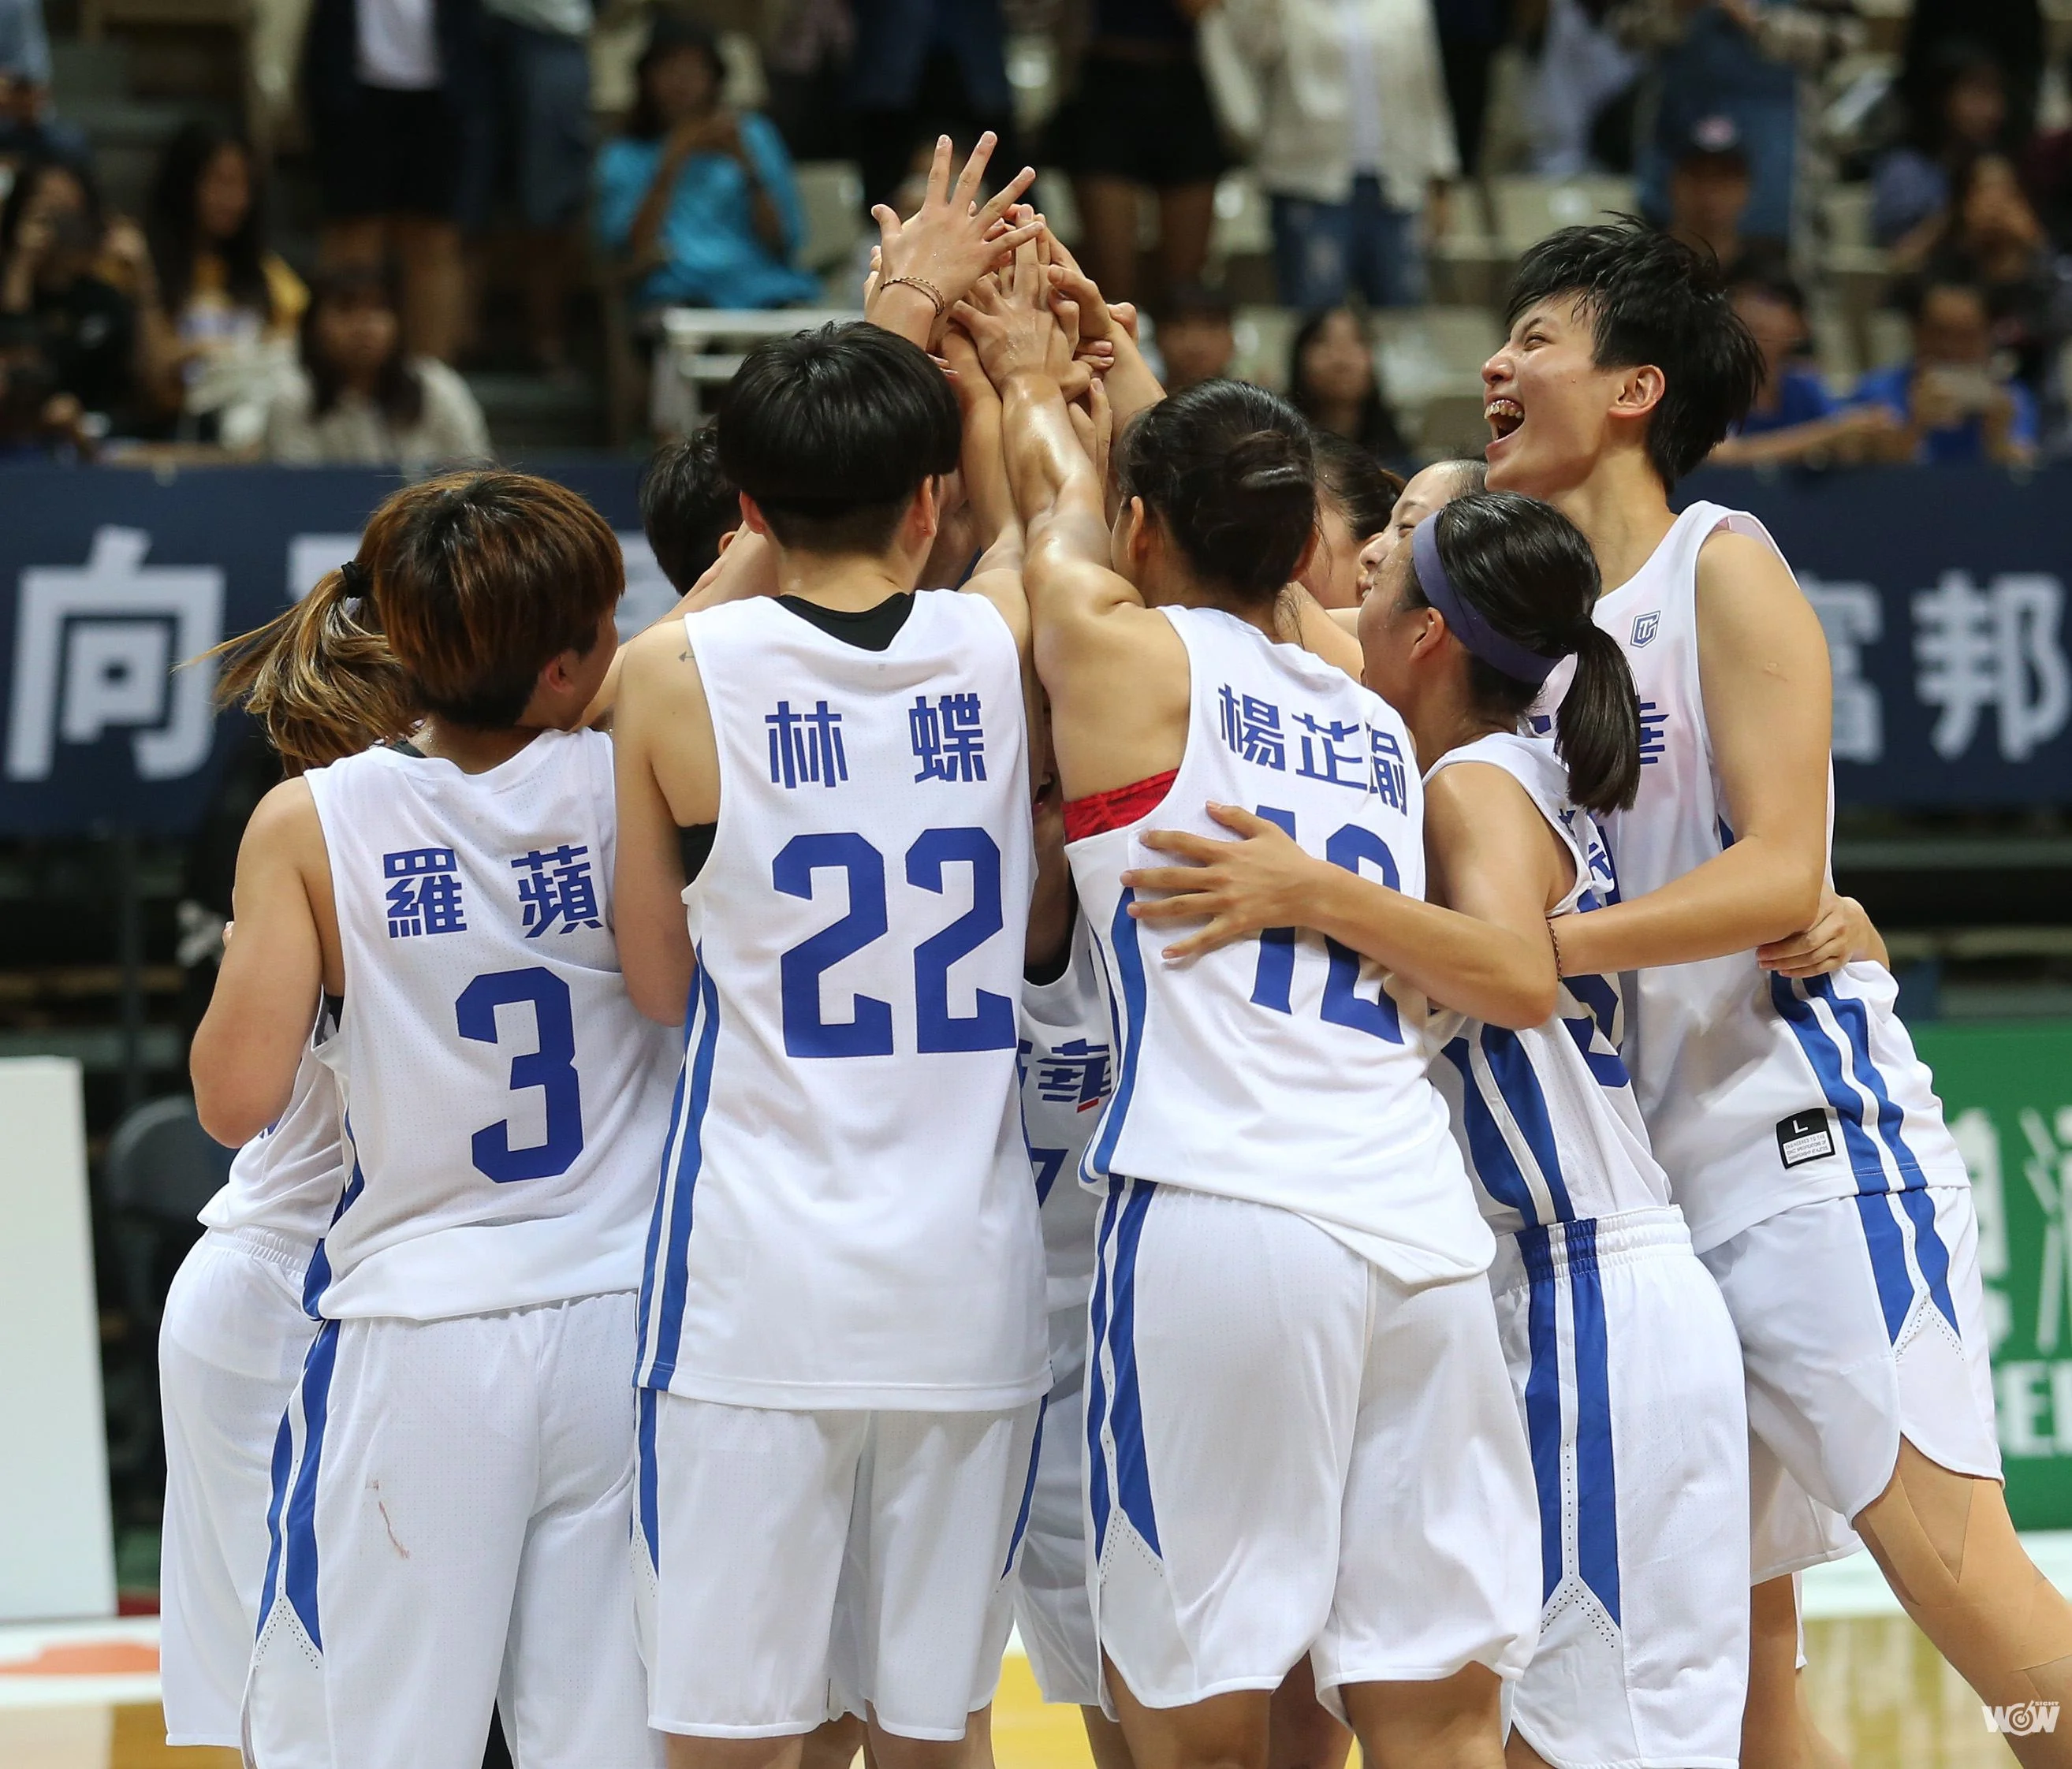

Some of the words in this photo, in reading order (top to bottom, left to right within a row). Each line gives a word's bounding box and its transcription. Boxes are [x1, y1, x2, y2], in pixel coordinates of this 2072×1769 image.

[6, 525, 226, 781] 向
[765, 692, 987, 789] 林蝶
[382, 844, 604, 939] 羅蘋
[772, 827, 1017, 1058] 22
[455, 966, 584, 1183] 3
[1792, 1119, 1809, 1134] L
